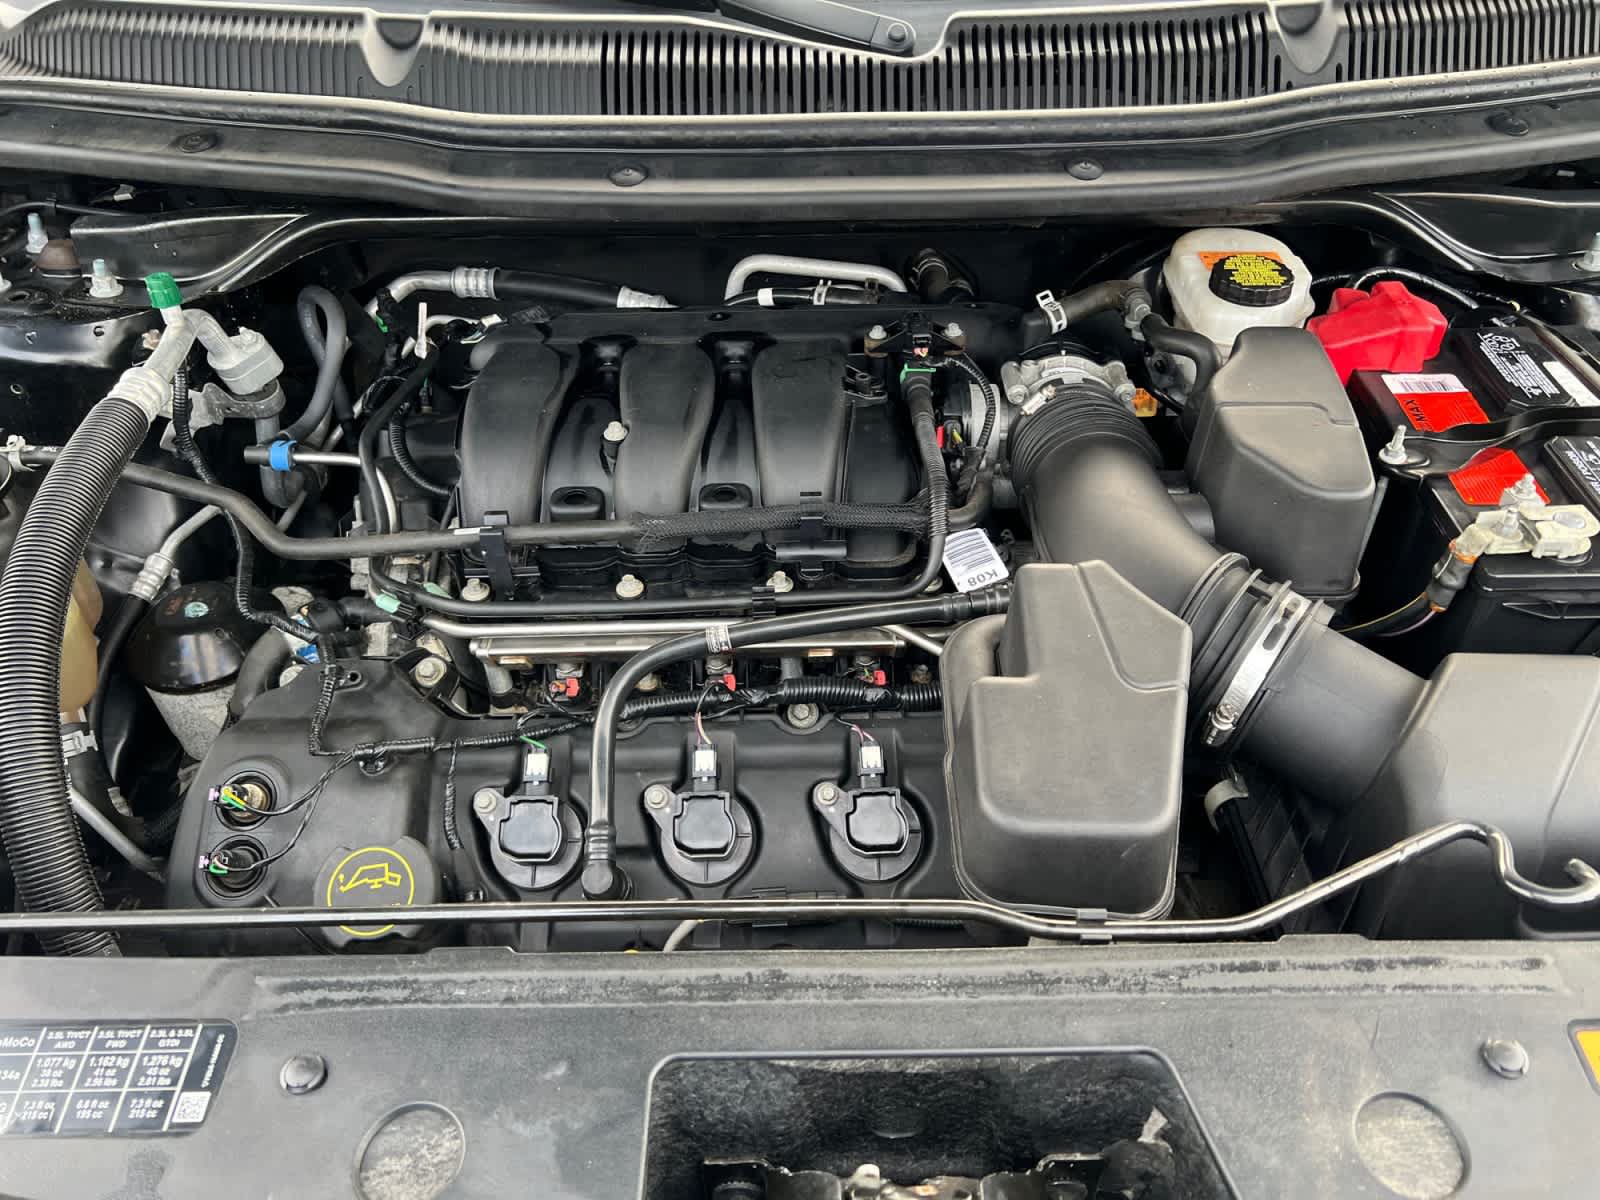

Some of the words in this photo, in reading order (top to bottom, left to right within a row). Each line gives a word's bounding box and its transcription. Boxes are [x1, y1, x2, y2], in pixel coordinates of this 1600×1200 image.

[1406, 399, 1428, 422] MAX
[967, 568, 998, 587] K08
[62, 1056, 77, 1070] kg
[116, 1055, 130, 1069] kg
[168, 1055, 184, 1068] kg
